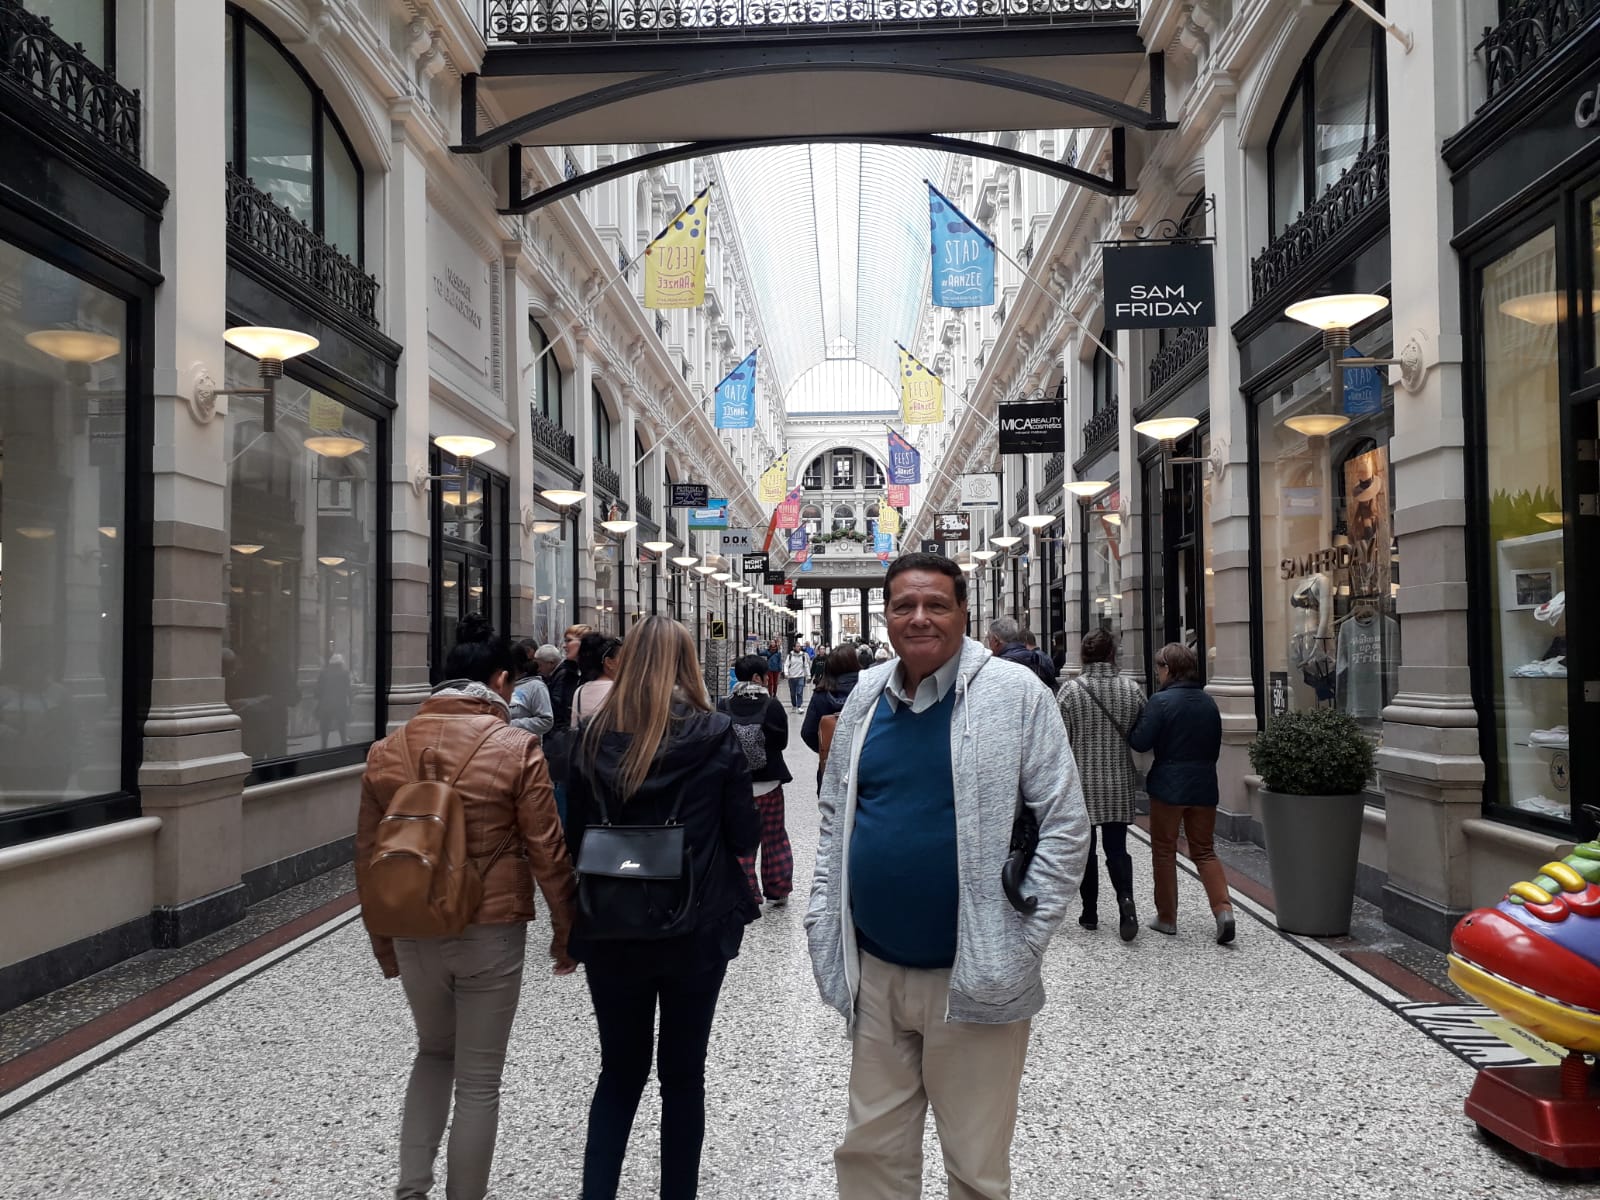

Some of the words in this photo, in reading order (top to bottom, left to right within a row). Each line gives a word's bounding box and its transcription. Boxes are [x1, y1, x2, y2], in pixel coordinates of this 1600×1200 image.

[945, 239, 979, 265] STAD
[1130, 285, 1185, 300] SAM
[1115, 301, 1204, 317] FRIDAY
[1001, 418, 1032, 431] MICA
[1031, 416, 1062, 424] BEAUTY
[894, 451, 914, 466] FEEST
[723, 536, 748, 544] DOK
